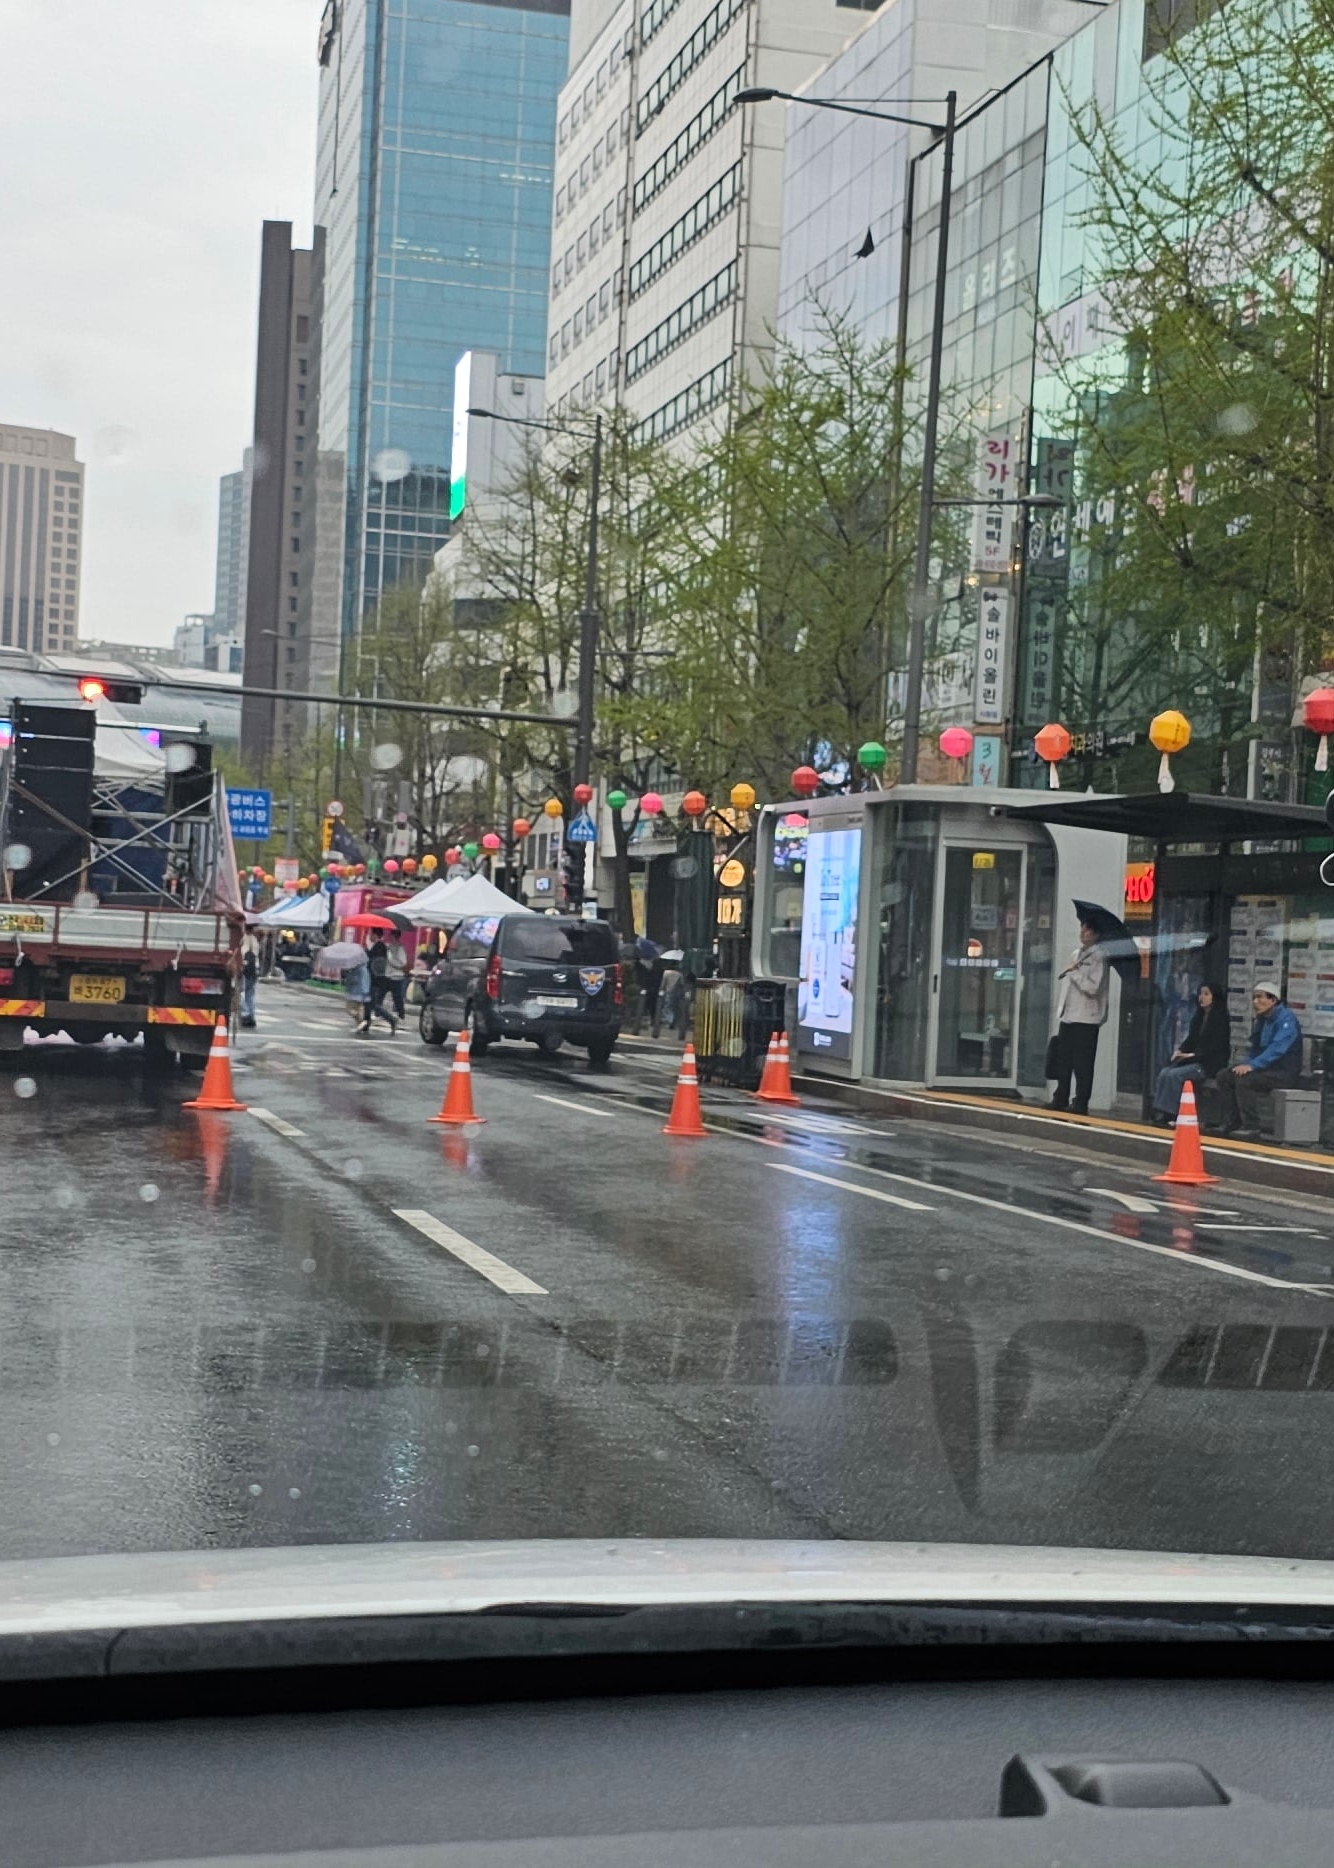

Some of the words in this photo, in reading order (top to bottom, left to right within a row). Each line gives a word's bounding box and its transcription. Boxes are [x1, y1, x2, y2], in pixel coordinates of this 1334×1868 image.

[985, 440, 1010, 484] 리가
[982, 606, 1002, 705] 솔바이올린
[226, 793, 266, 807] 광버스
[229, 808, 267, 823] 하차장
[85, 985, 121, 1000] 3760
